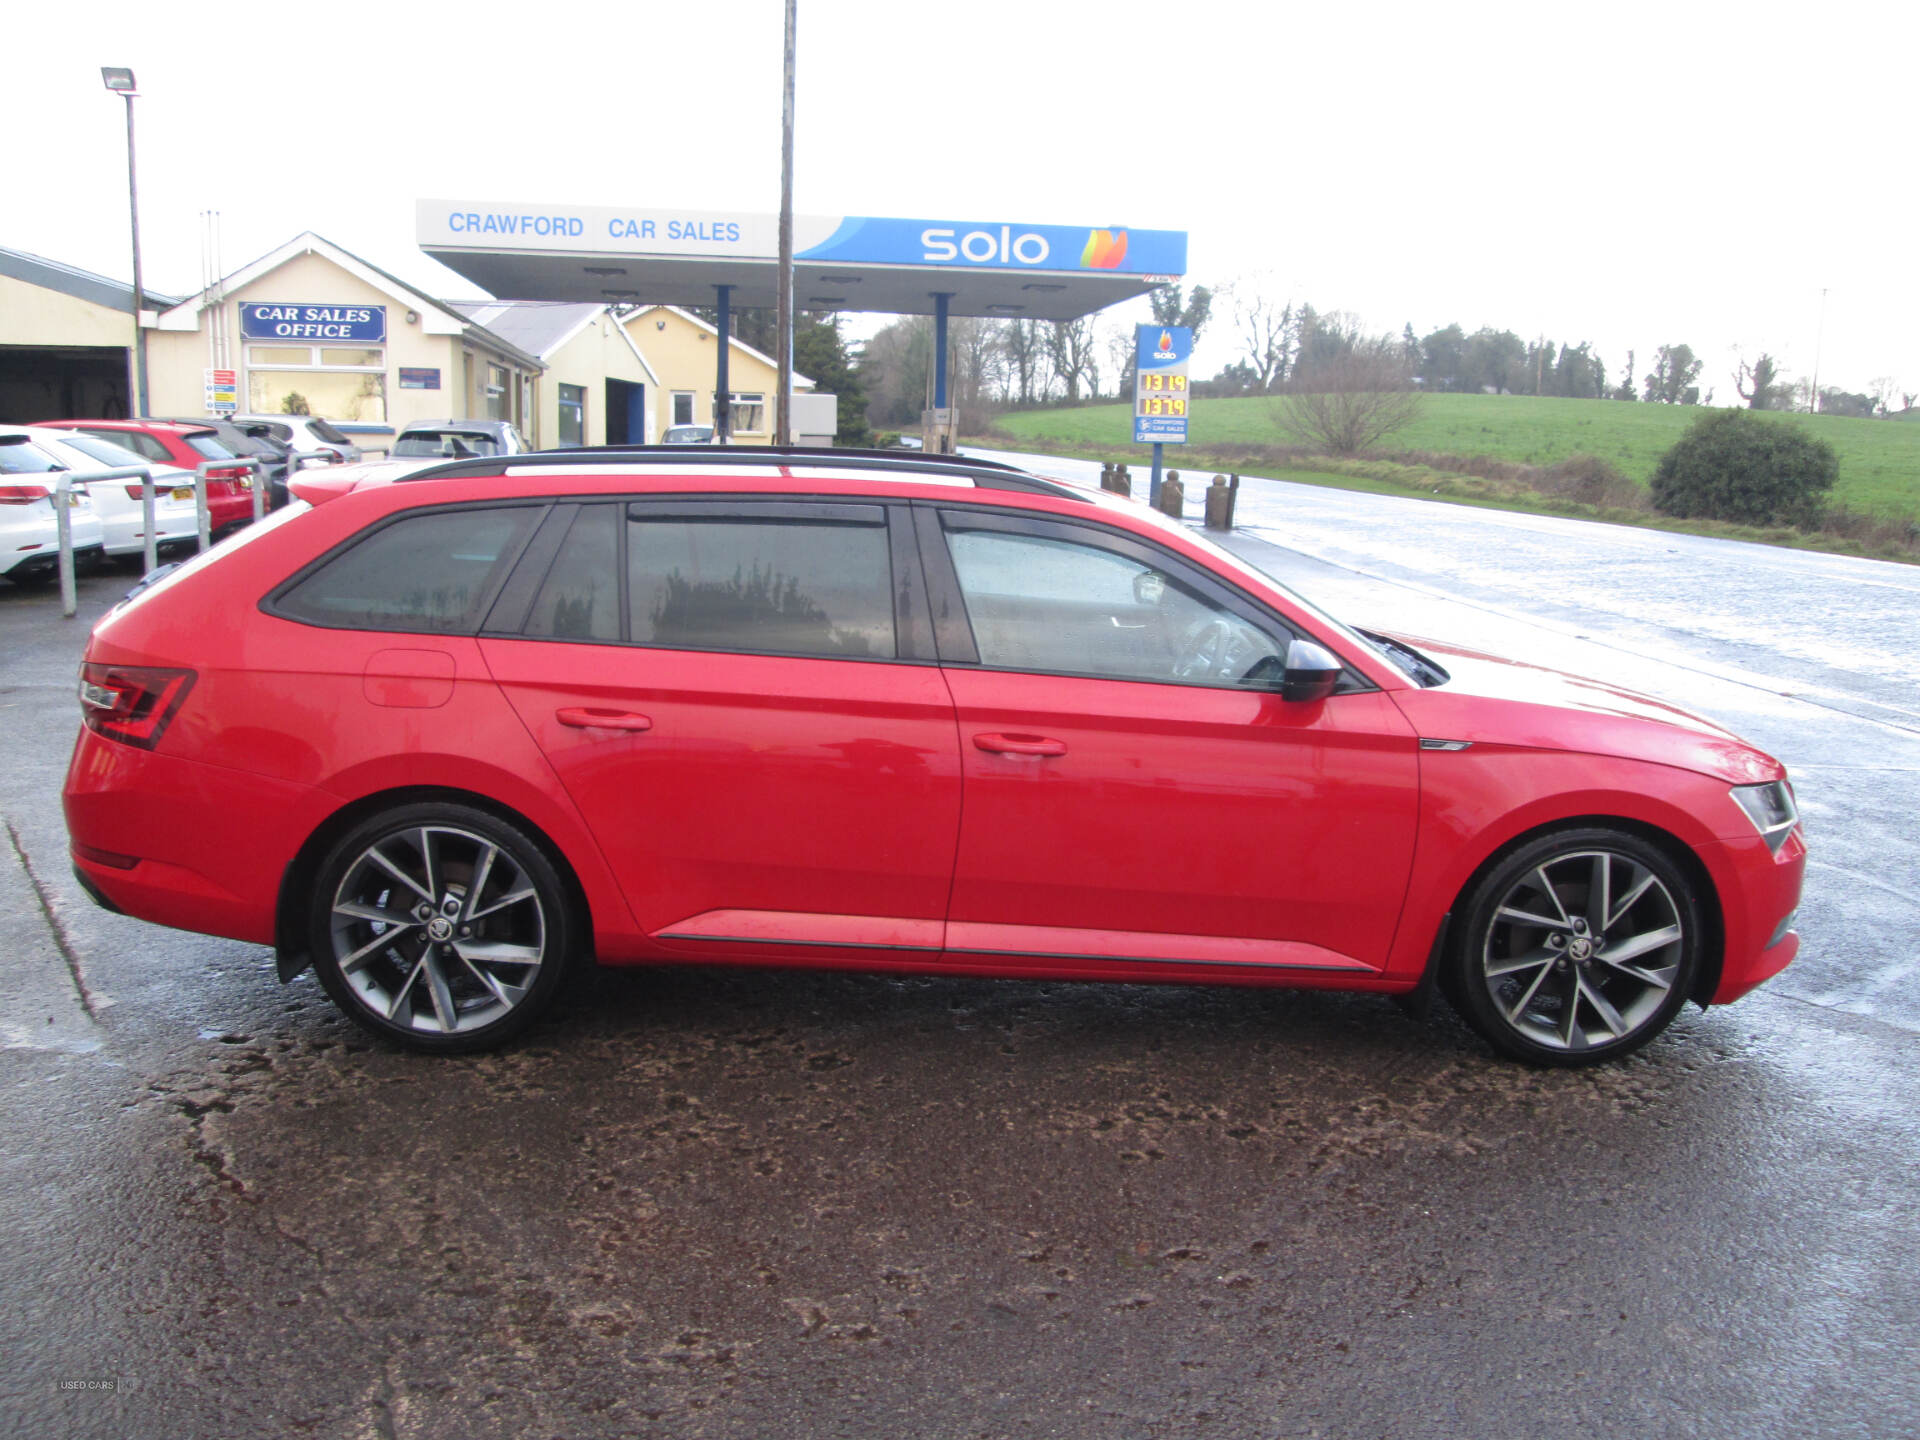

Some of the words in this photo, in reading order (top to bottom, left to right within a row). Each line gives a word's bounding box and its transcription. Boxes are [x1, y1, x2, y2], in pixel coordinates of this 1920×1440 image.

[449, 212, 584, 237] CRAWFORD
[608, 218, 656, 239] CAR
[667, 220, 740, 242] SALES
[921, 225, 1050, 265] solo
[255, 307, 299, 321] CAR
[304, 308, 371, 323] SALES
[275, 323, 352, 338] OFFICE
